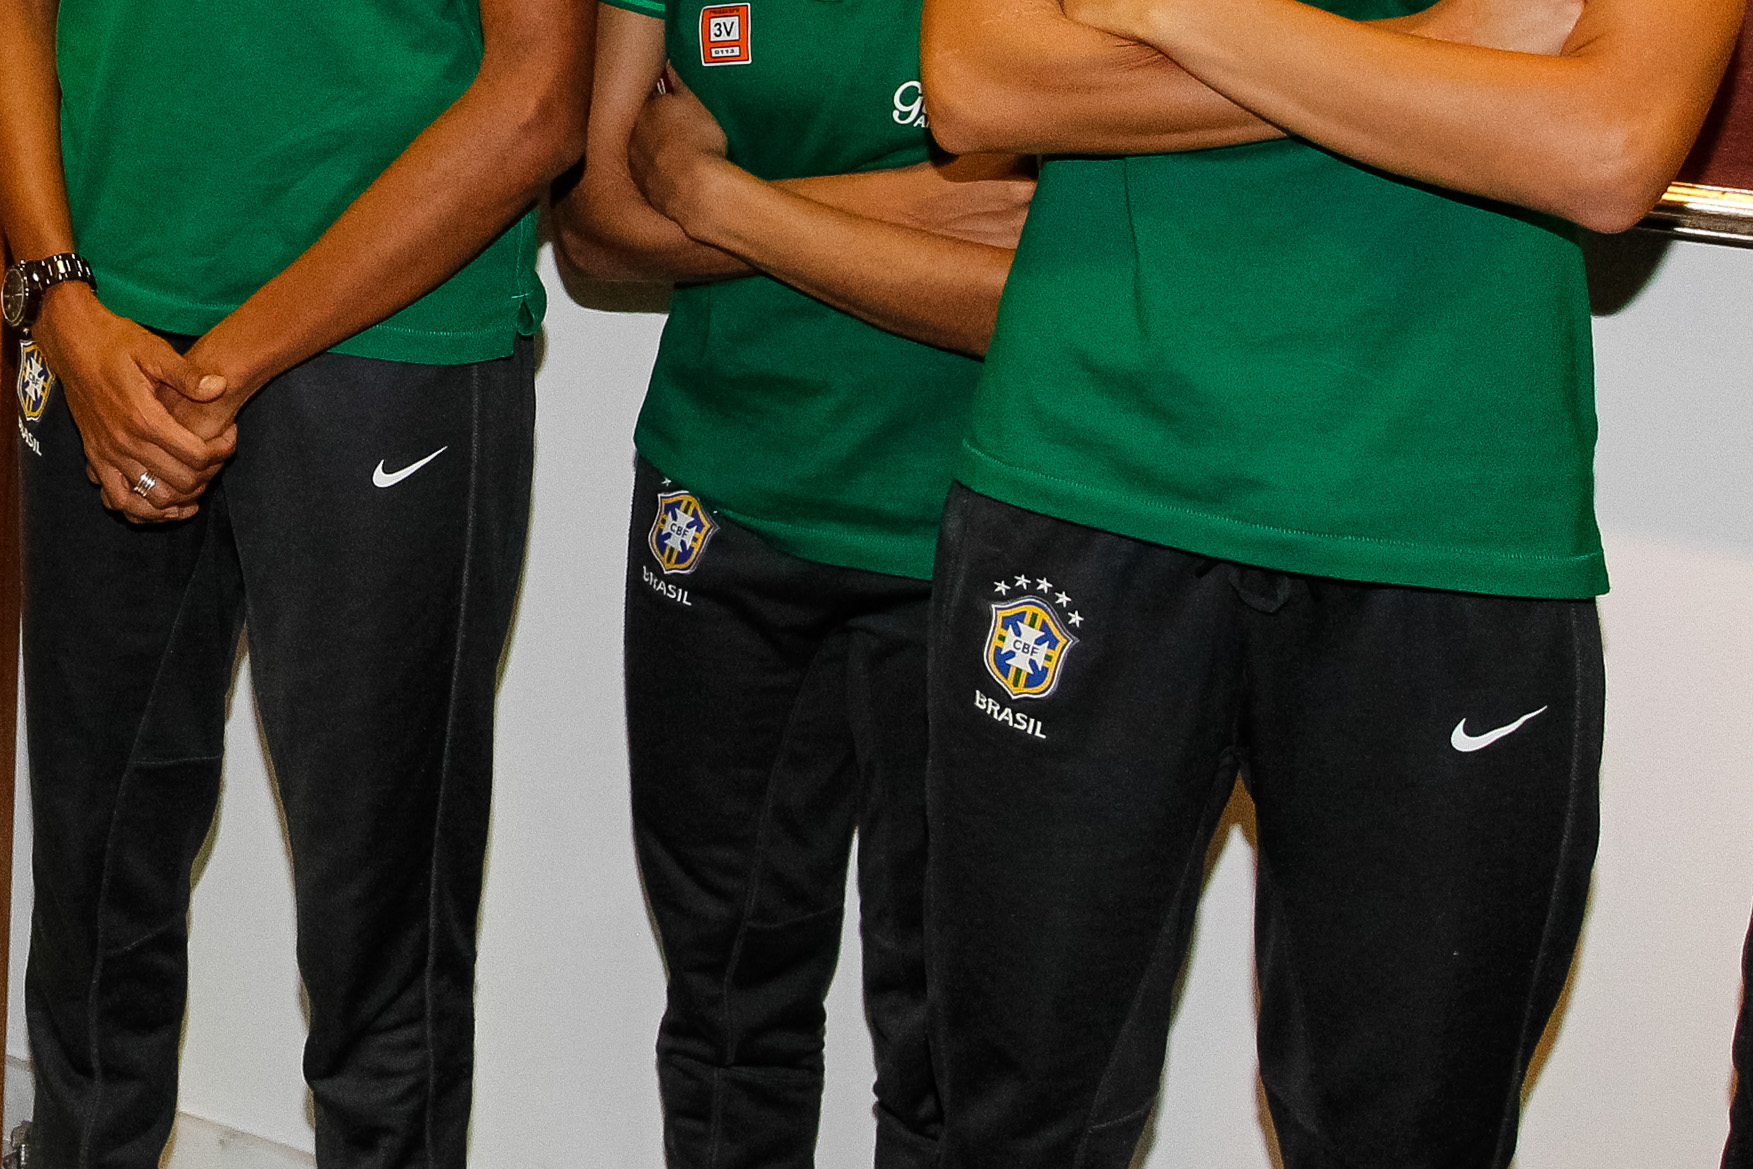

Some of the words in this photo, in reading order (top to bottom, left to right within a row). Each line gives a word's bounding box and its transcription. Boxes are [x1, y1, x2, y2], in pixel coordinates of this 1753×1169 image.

[713, 21, 735, 38] 3V
[670, 522, 689, 538] CBF
[1012, 638, 1039, 656] CBF
[973, 689, 1047, 739] BRASIL
